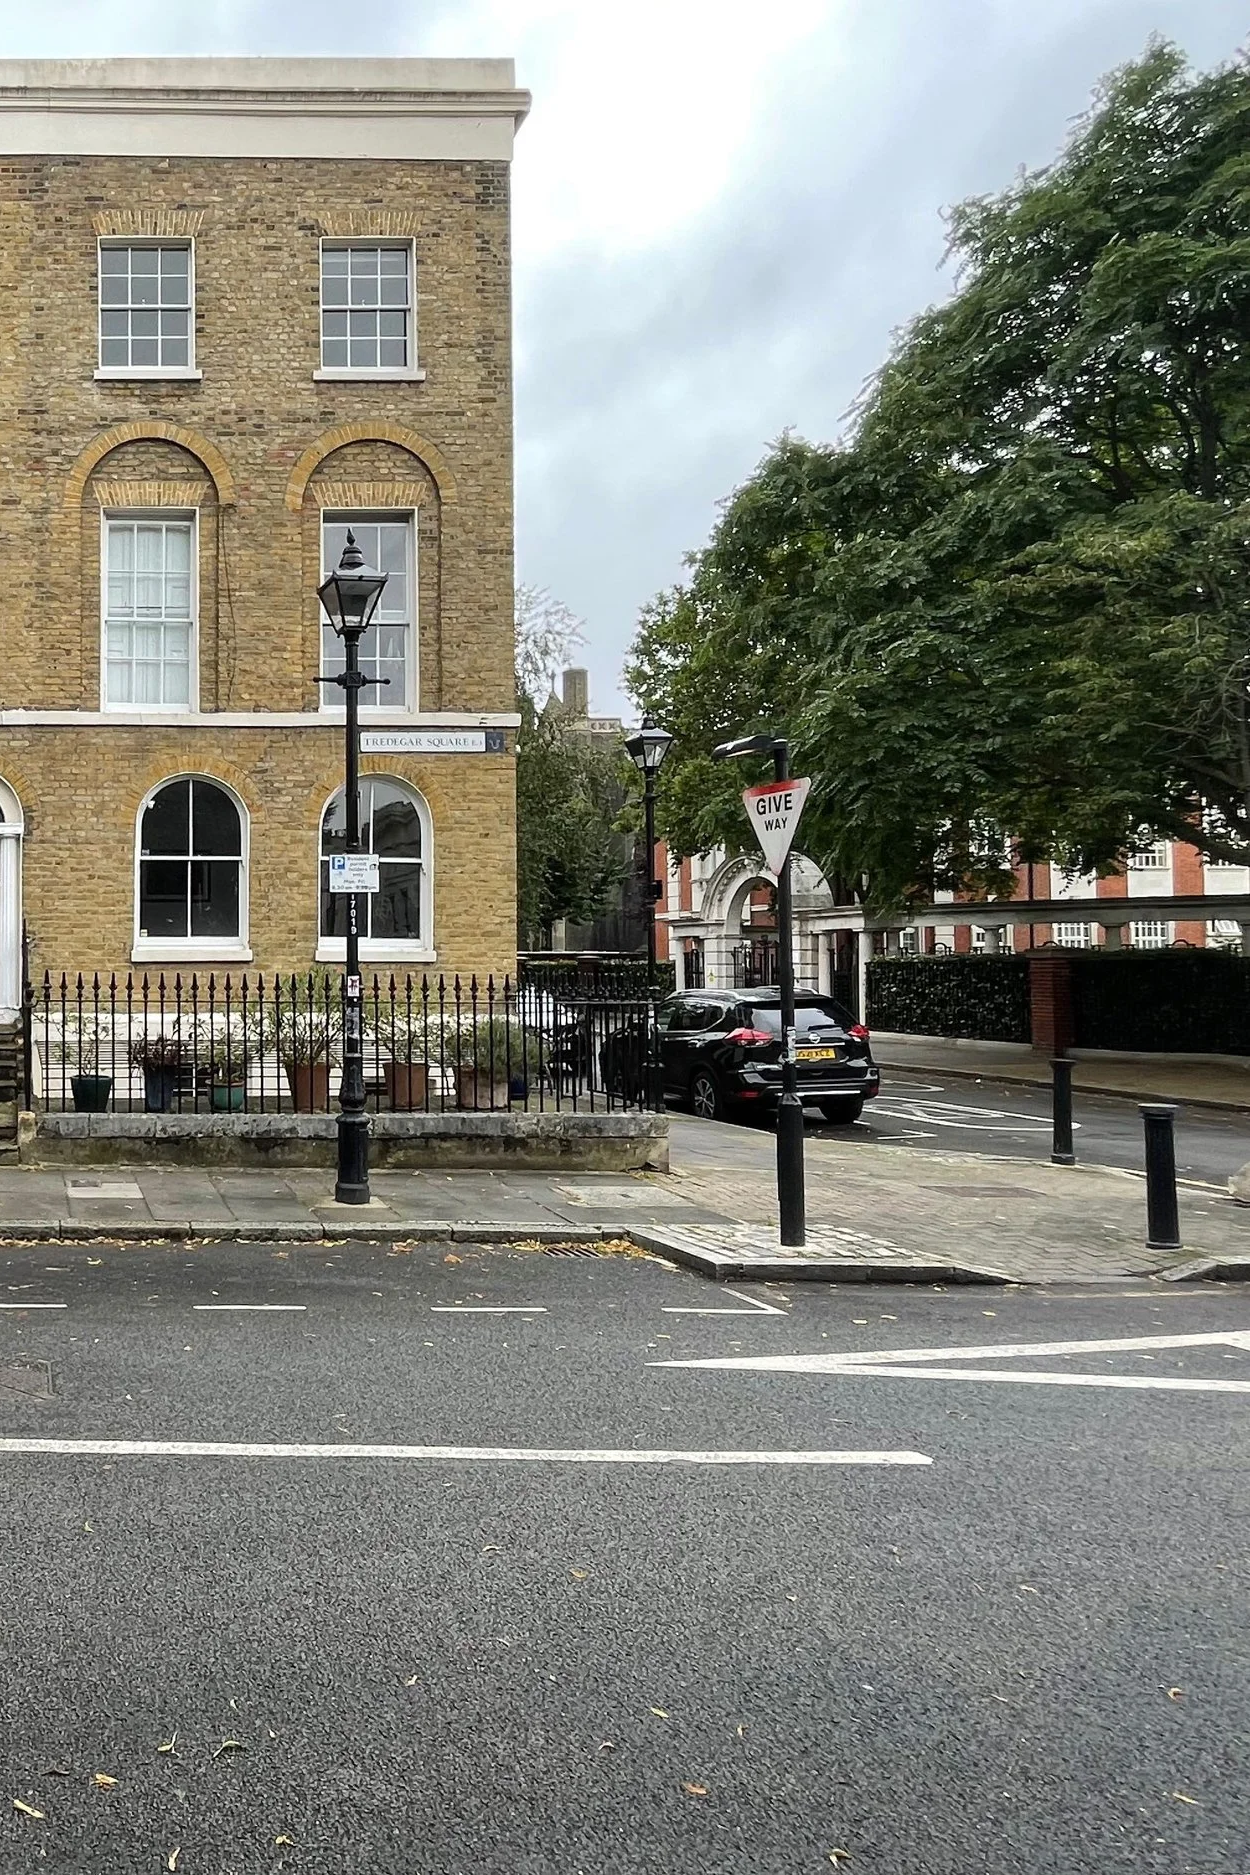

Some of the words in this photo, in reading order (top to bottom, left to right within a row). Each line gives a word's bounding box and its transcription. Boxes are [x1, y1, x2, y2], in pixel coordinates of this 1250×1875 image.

[365, 737, 423, 746] TREDEGAR
[427, 737, 469, 747] SQUARE
[756, 793, 793, 815] GIVE
[764, 817, 788, 831] WAY
[334, 857, 344, 869] P
